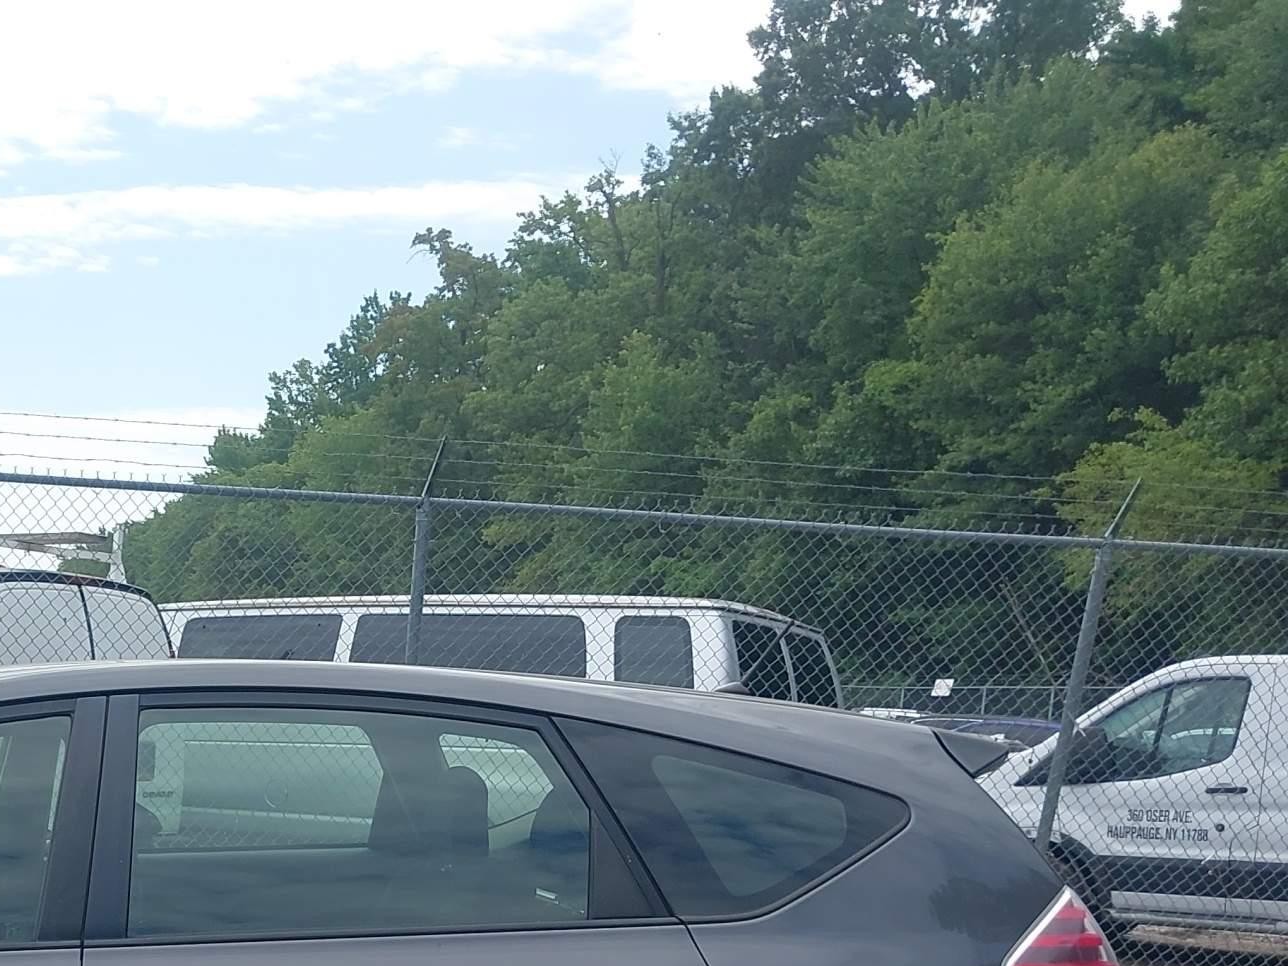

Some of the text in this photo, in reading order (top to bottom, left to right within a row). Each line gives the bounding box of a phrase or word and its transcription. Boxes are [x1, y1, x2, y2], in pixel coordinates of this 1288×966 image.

[1126, 808, 1144, 822] 360
[1145, 809, 1171, 823] OSER
[1165, 827, 1178, 841] NY
[1181, 828, 1209, 842] 11788
